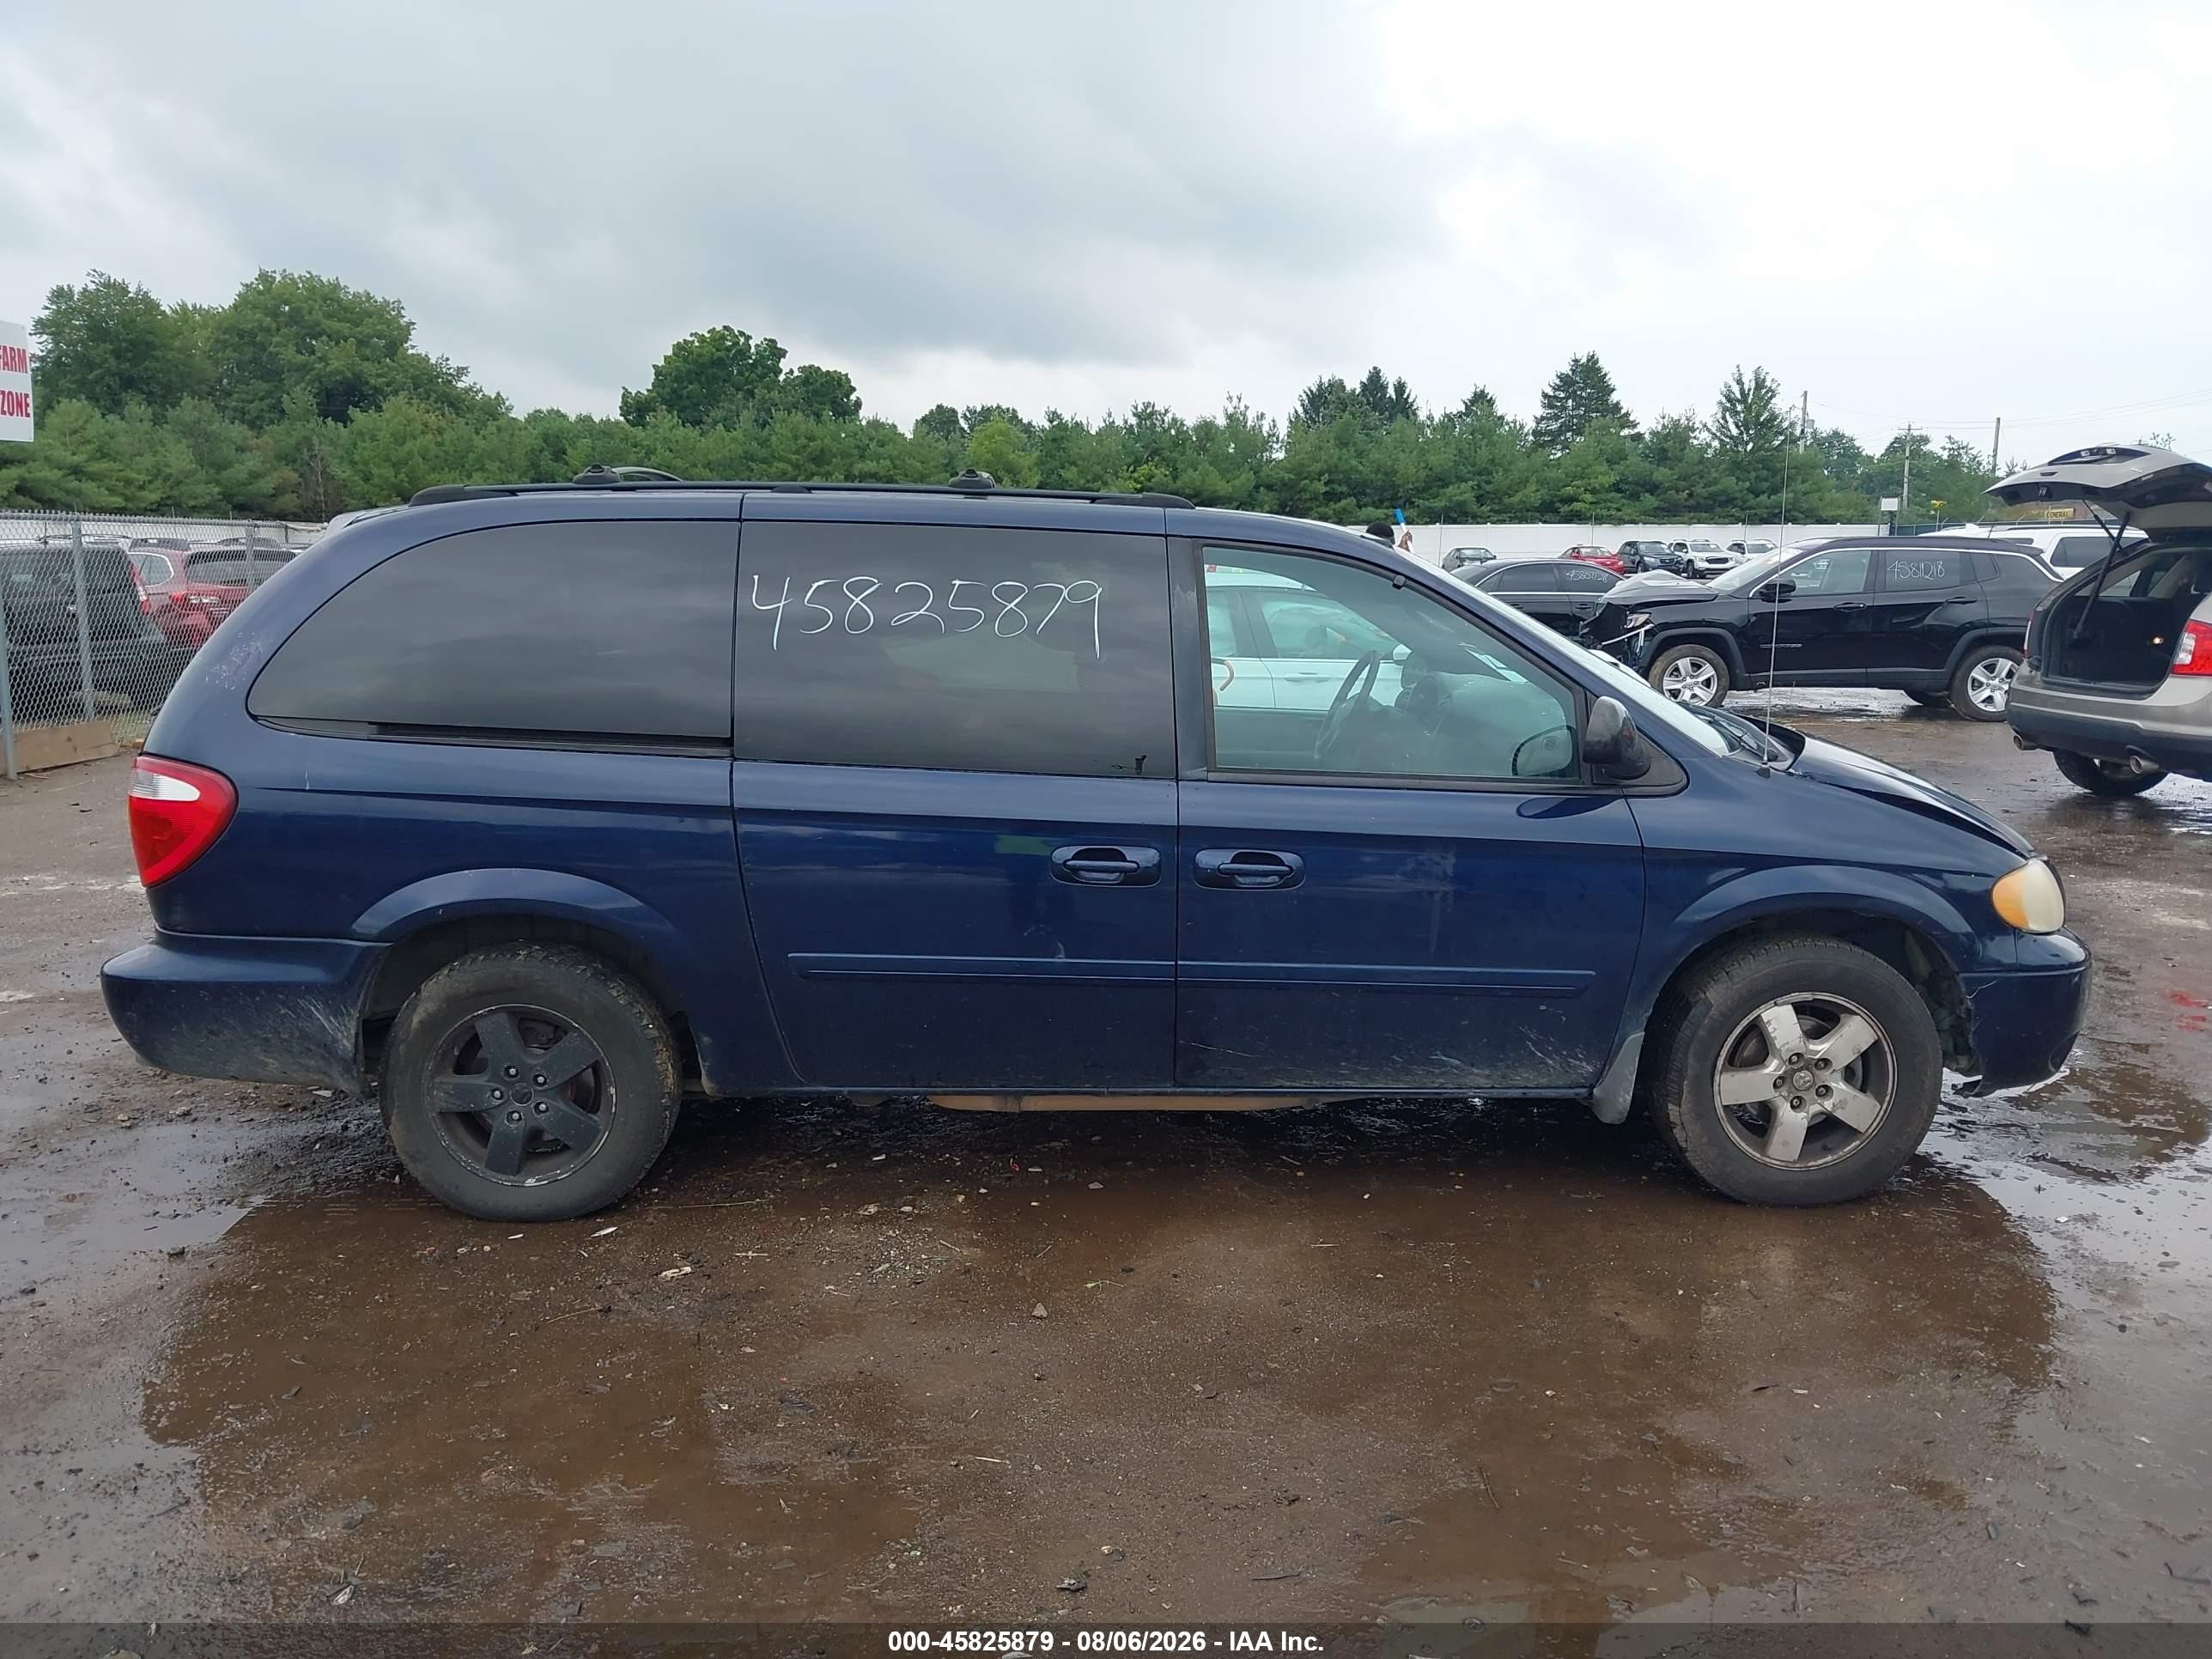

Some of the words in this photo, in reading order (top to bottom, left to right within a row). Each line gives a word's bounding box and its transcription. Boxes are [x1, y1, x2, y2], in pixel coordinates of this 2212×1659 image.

[0, 345, 28, 374] ARM
[0, 390, 31, 418] ZONE
[1887, 560, 1946, 580] 45811218
[751, 574, 1103, 659] 45825879
